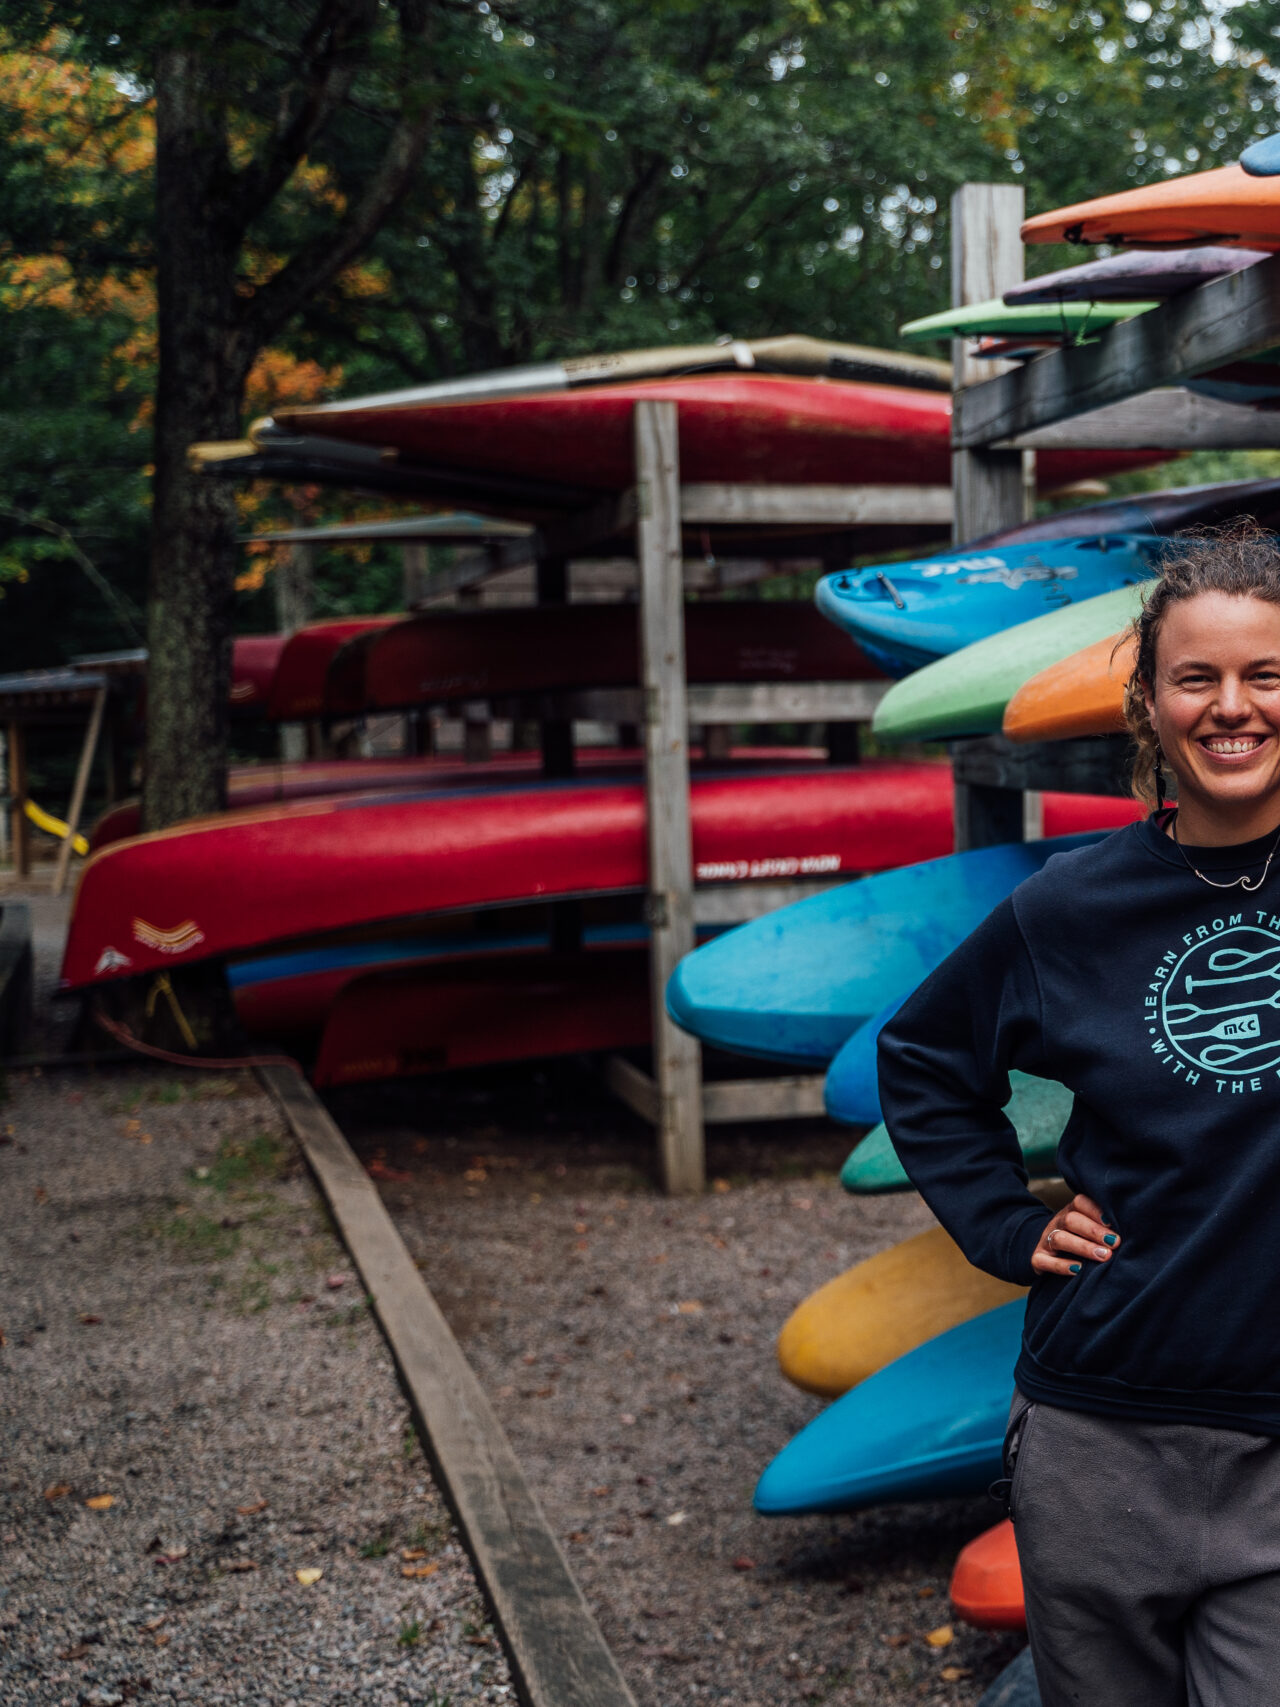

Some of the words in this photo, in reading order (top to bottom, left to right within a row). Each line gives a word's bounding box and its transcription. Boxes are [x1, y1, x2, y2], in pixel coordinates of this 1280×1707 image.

[1143, 950, 1178, 1021] LEARN
[1182, 912, 1243, 946] FROM
[1150, 1037, 1201, 1086] WITH
[1215, 1077, 1262, 1094] THE
